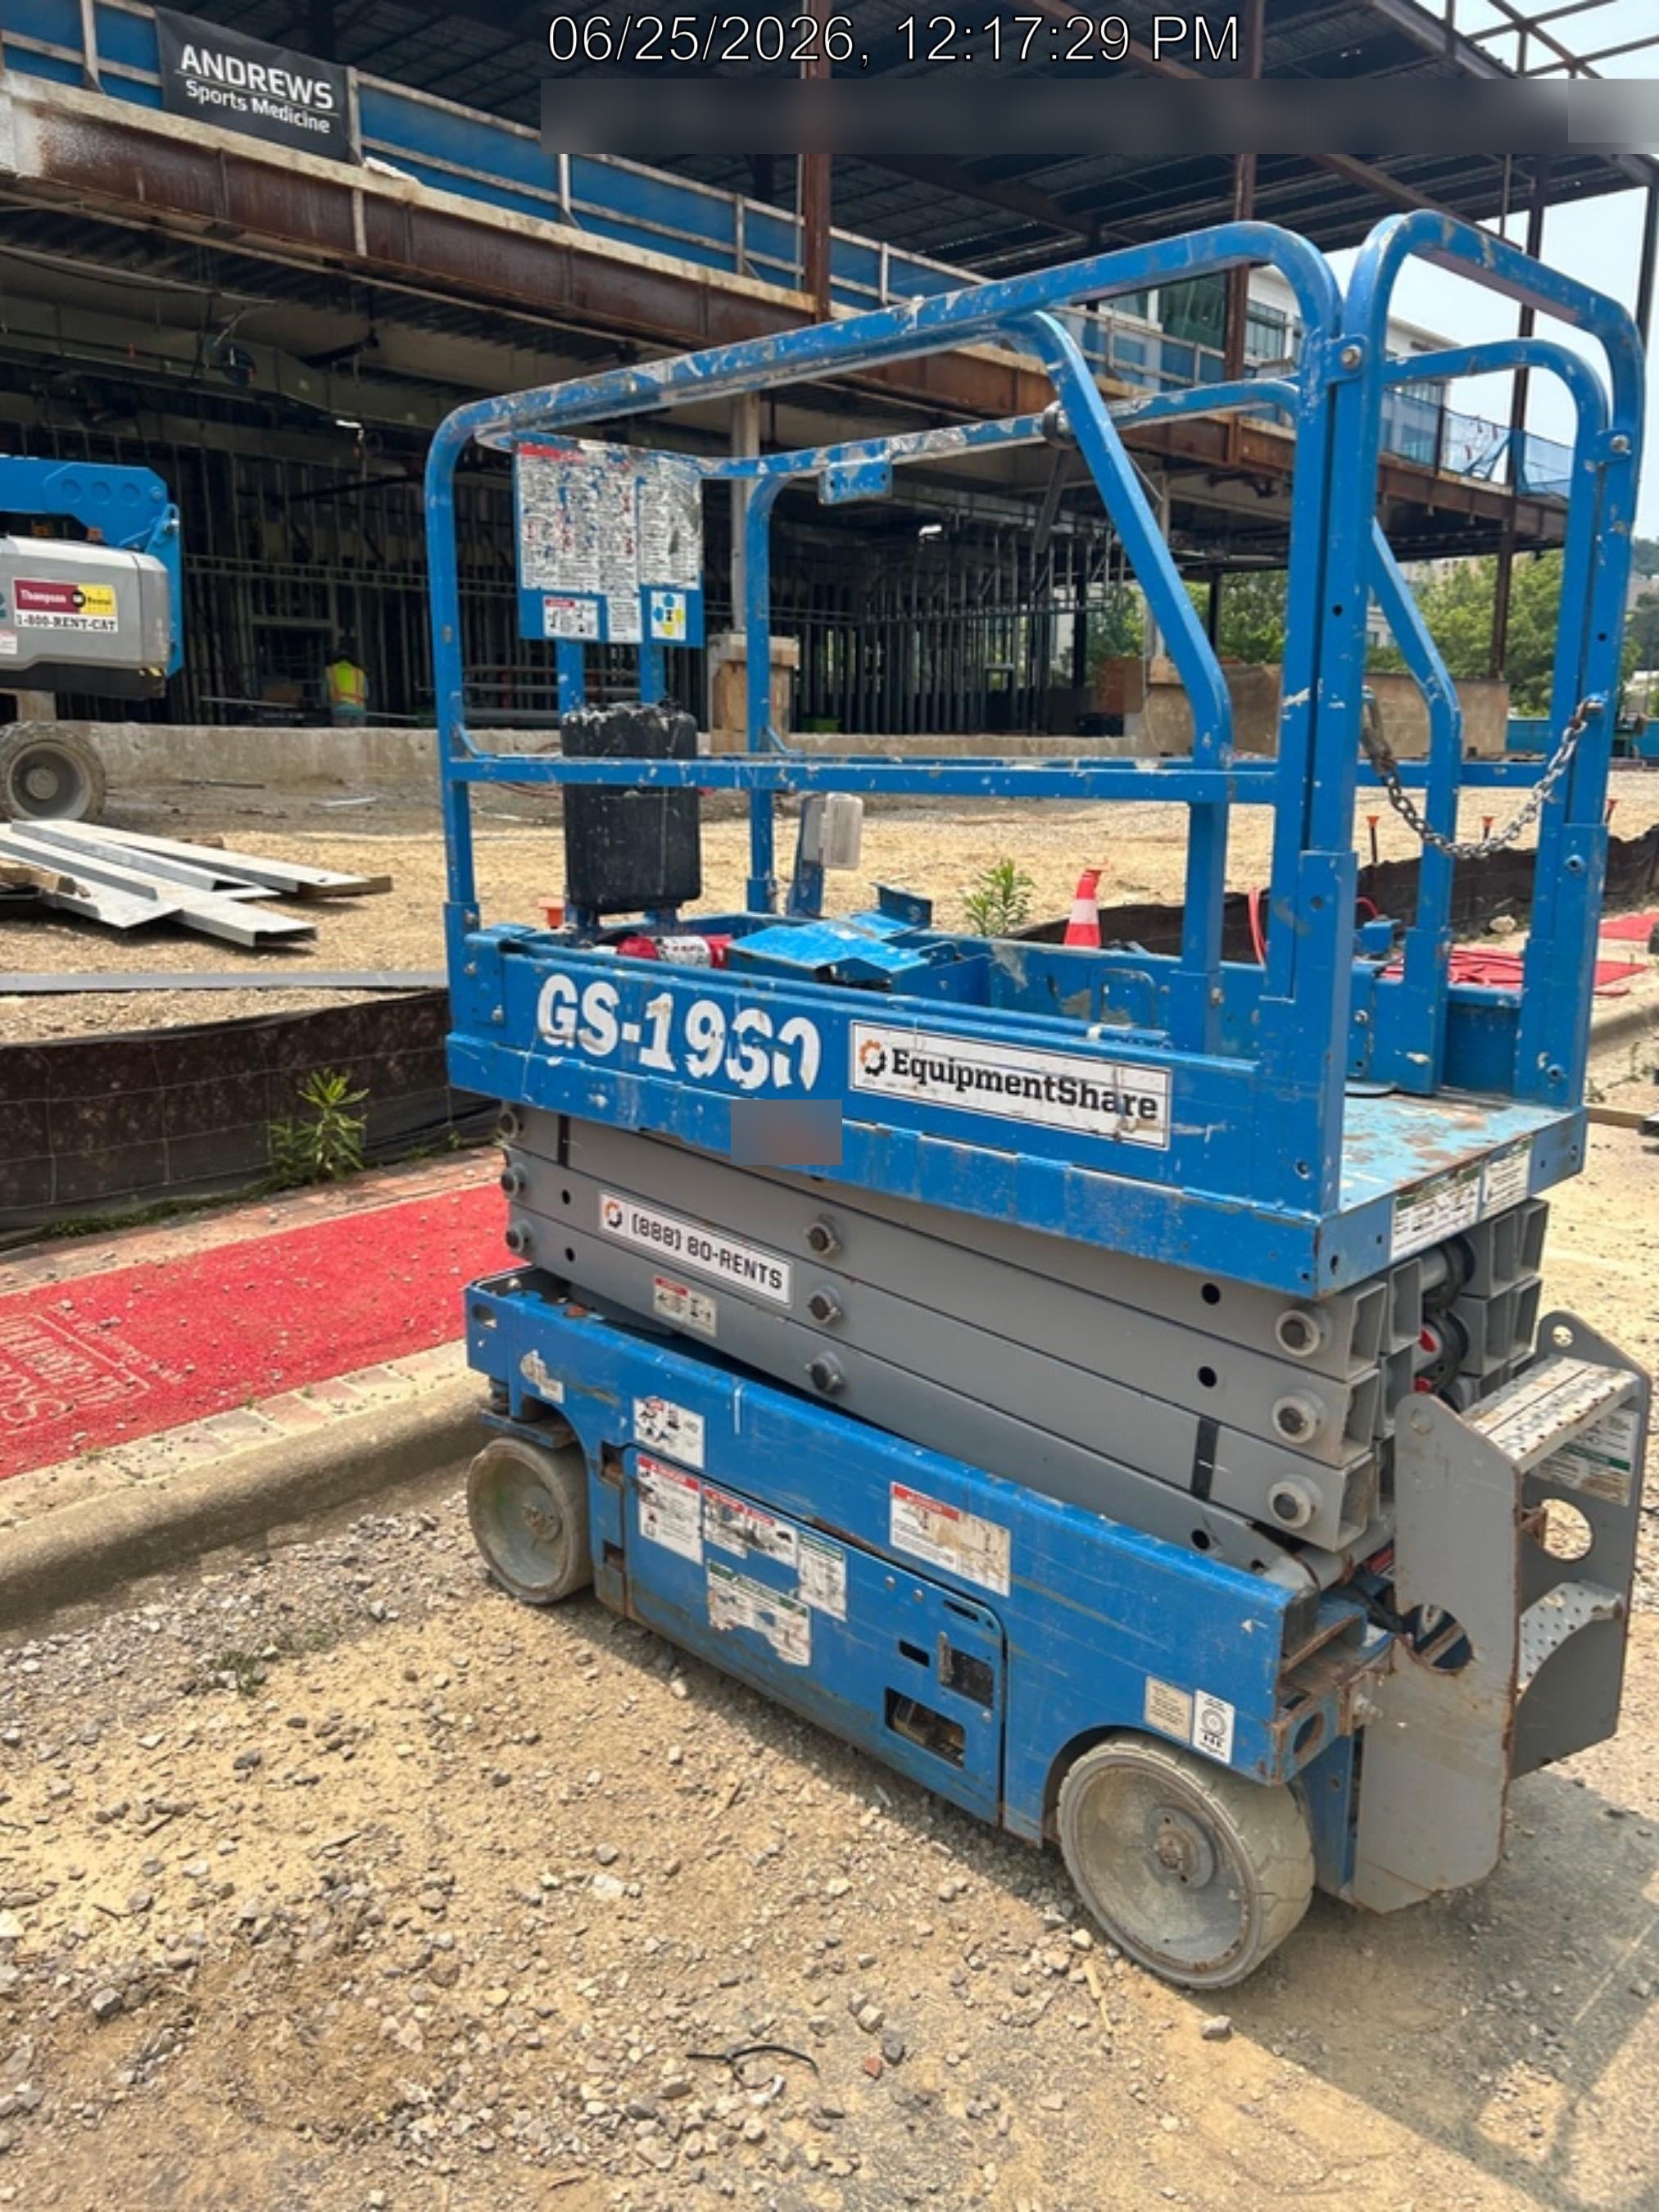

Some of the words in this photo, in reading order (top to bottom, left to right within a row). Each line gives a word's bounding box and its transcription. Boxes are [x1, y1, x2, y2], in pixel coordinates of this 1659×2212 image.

[180, 43, 333, 110] ANDREWS
[185, 78, 248, 112] Sports
[251, 97, 331, 134] Medicine
[16, 614, 116, 630] 1-800-RENT-CAT
[891, 1048, 1158, 1122] EquipmentShare
[631, 1213, 682, 1251] (888)
[687, 1235, 783, 1290] 80-RENTS
